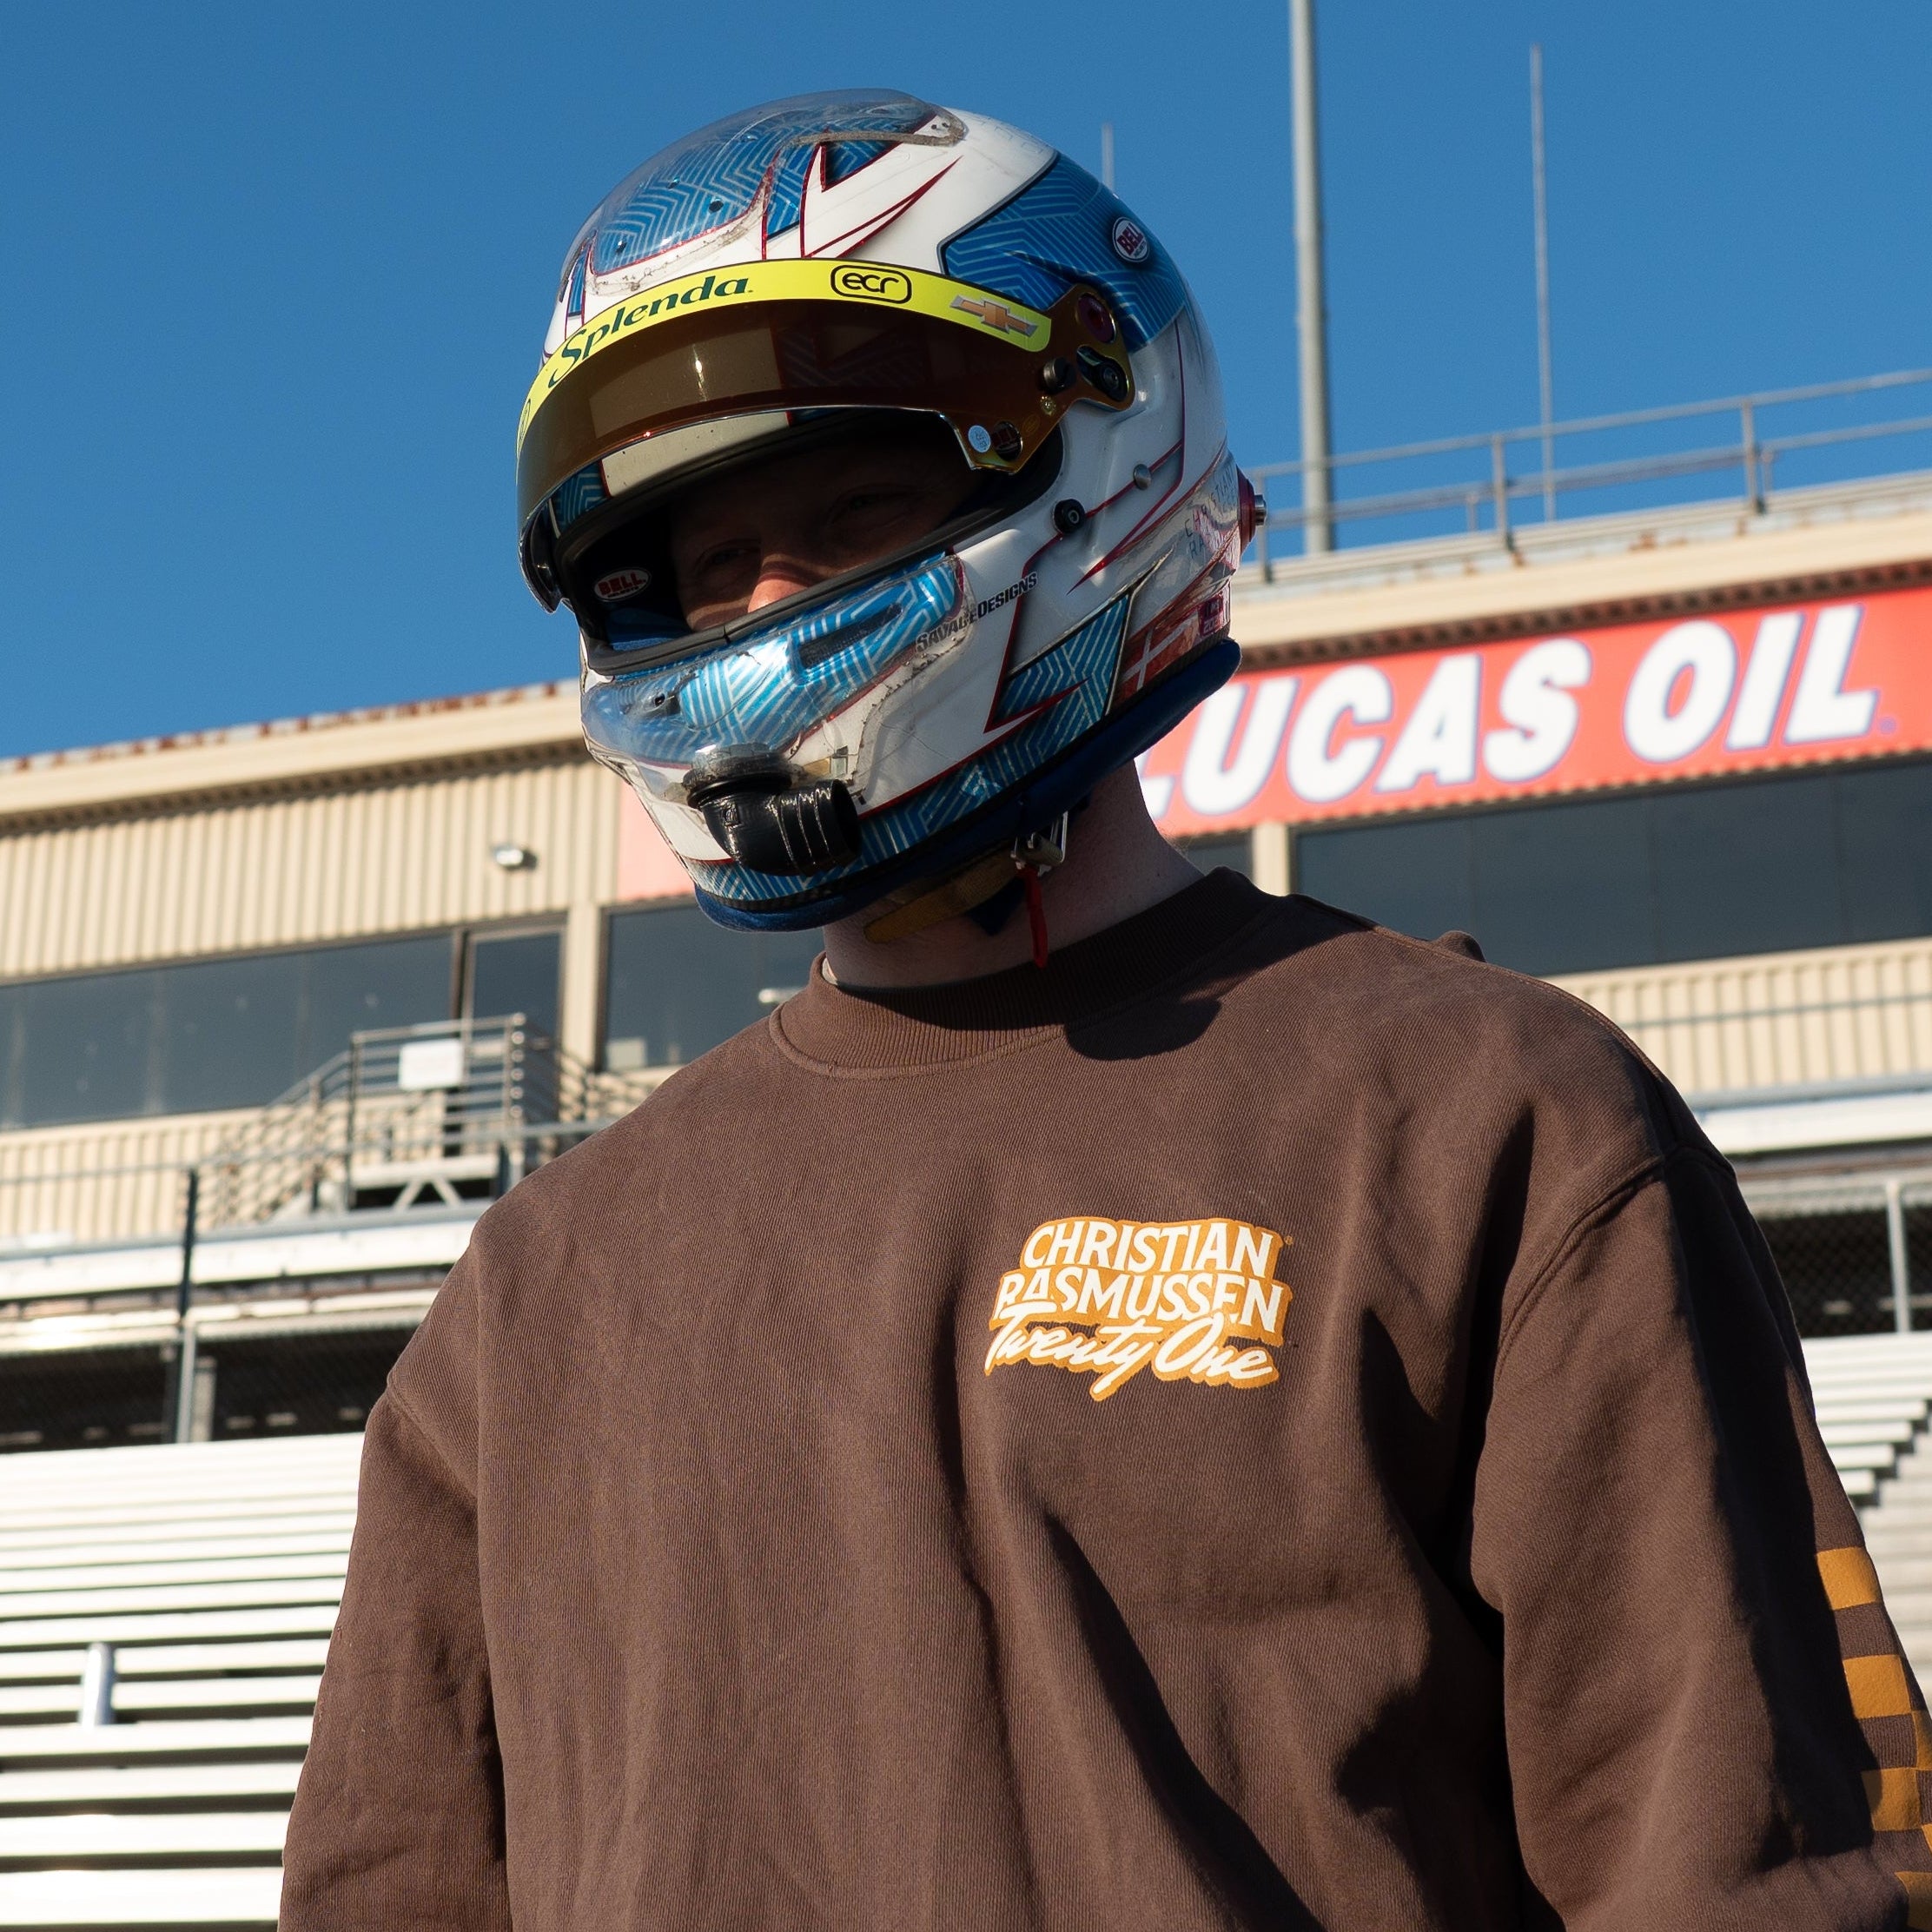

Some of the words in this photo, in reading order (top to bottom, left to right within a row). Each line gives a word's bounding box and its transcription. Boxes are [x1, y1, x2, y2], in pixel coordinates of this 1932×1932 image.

[1117, 222, 1144, 255] BELL
[842, 272, 899, 294] ecr
[548, 275, 747, 388] Splenda
[598, 572, 646, 596] BELL
[1623, 603, 1878, 764] OIL
[1023, 1220, 1274, 1279] CHRISTIAN
[993, 1267, 1284, 1334] RASMUSSEN
[984, 1301, 1164, 1394] Twenty
[1155, 1313, 1274, 1380] One
